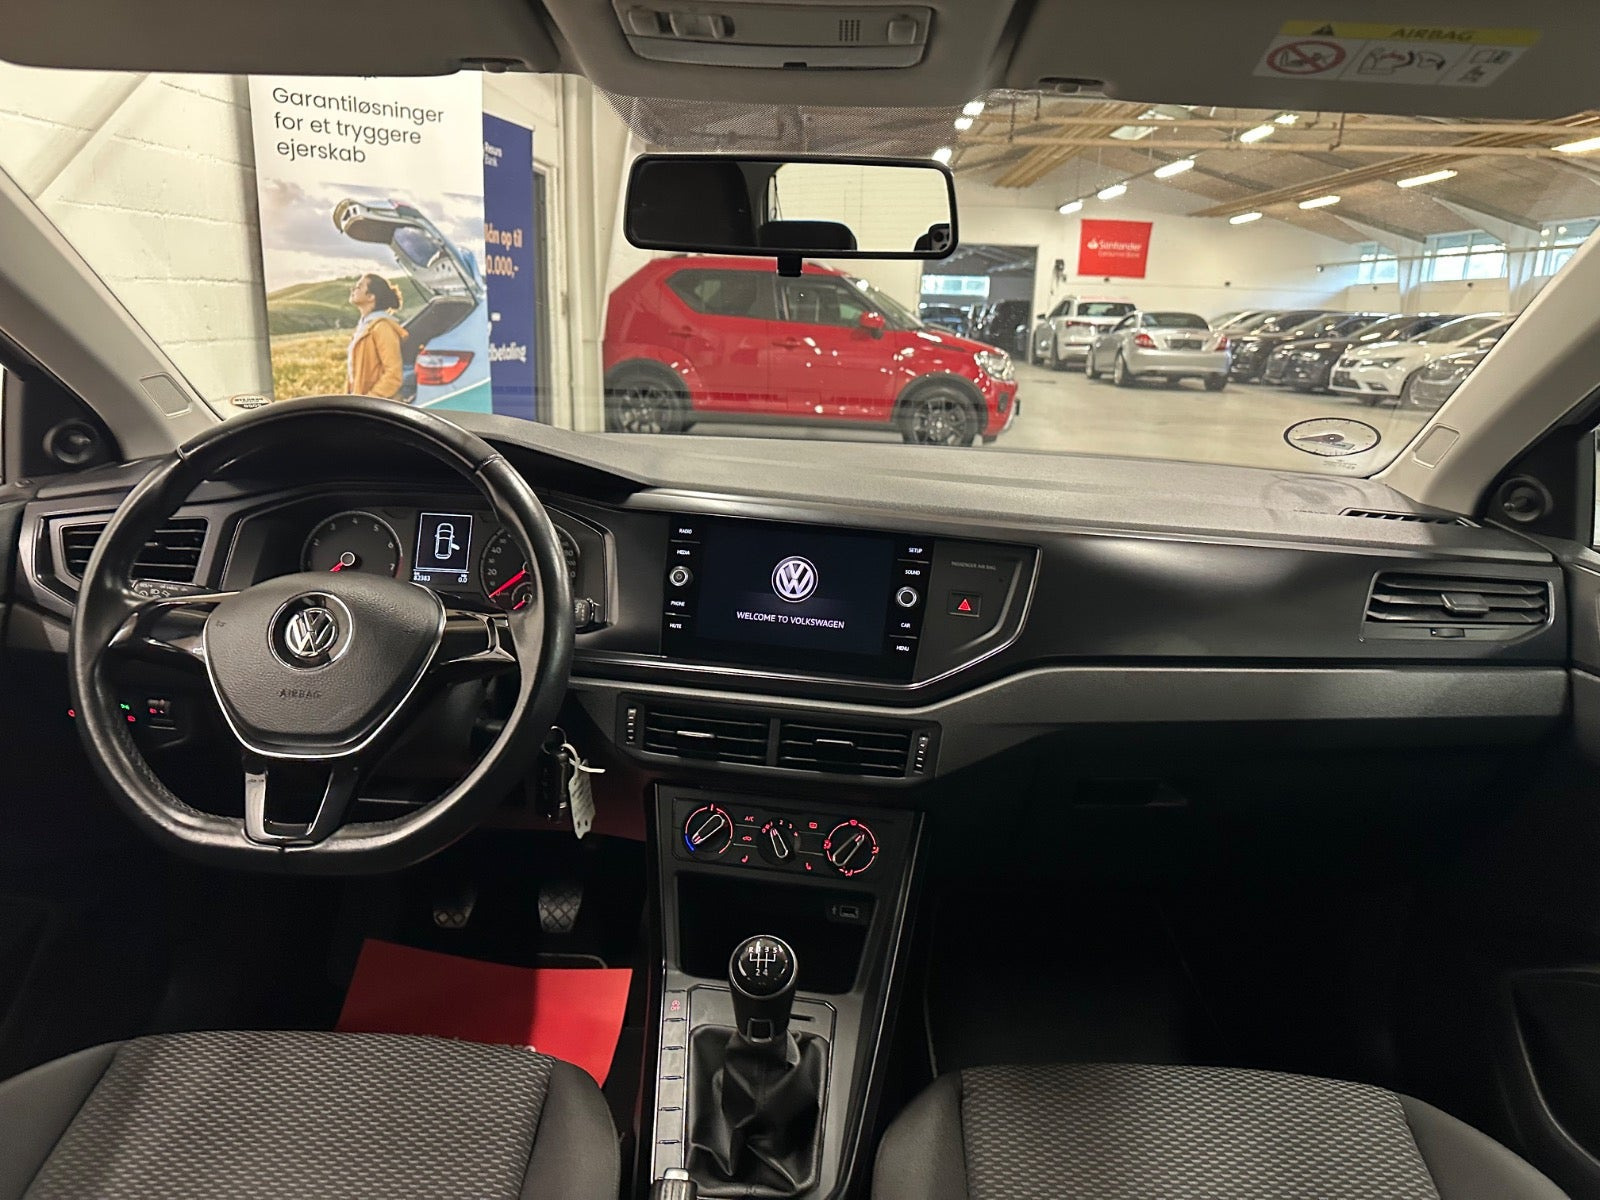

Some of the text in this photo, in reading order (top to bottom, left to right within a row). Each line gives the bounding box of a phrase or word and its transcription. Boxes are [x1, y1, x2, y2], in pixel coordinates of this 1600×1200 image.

[1391, 28, 1474, 41] AIRBAG
[272, 87, 444, 126] Garantiløsninger
[274, 112, 421, 146] for et tryggere
[276, 138, 366, 163] ejerskab
[736, 611, 846, 629] WELCOME TO VOLKSWAGEN
